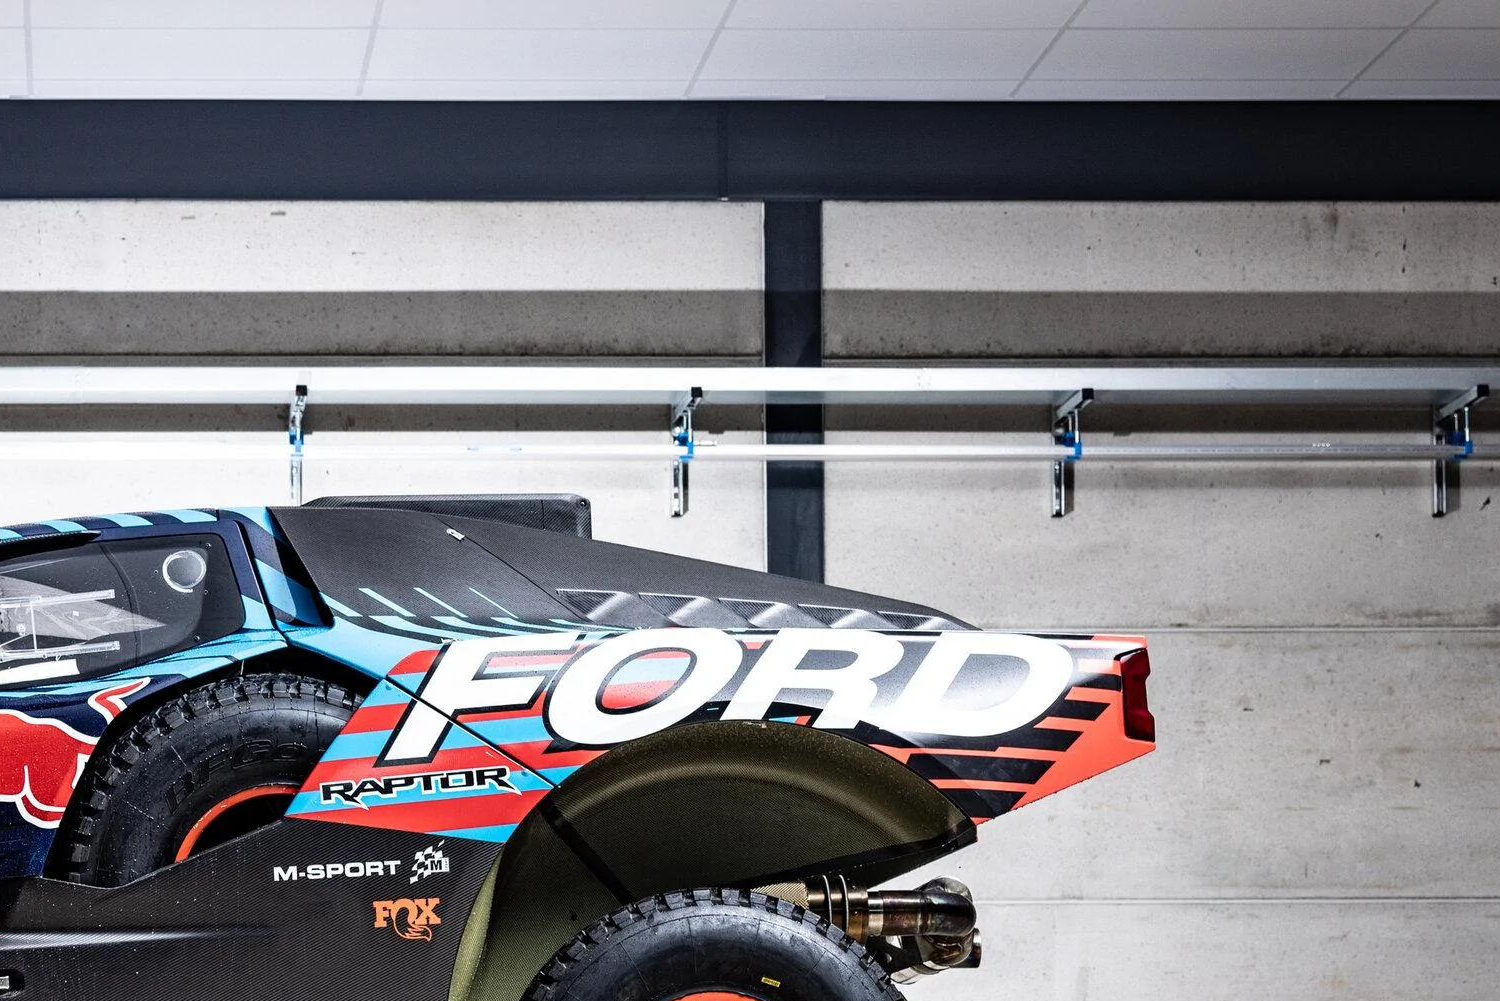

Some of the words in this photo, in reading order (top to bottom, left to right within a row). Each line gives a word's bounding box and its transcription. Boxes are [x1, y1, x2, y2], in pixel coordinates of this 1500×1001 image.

[374, 627, 1074, 767] FORD
[320, 766, 522, 810] RAPTOR
[273, 860, 401, 882] M-SPORT
[372, 897, 442, 941] FOX
